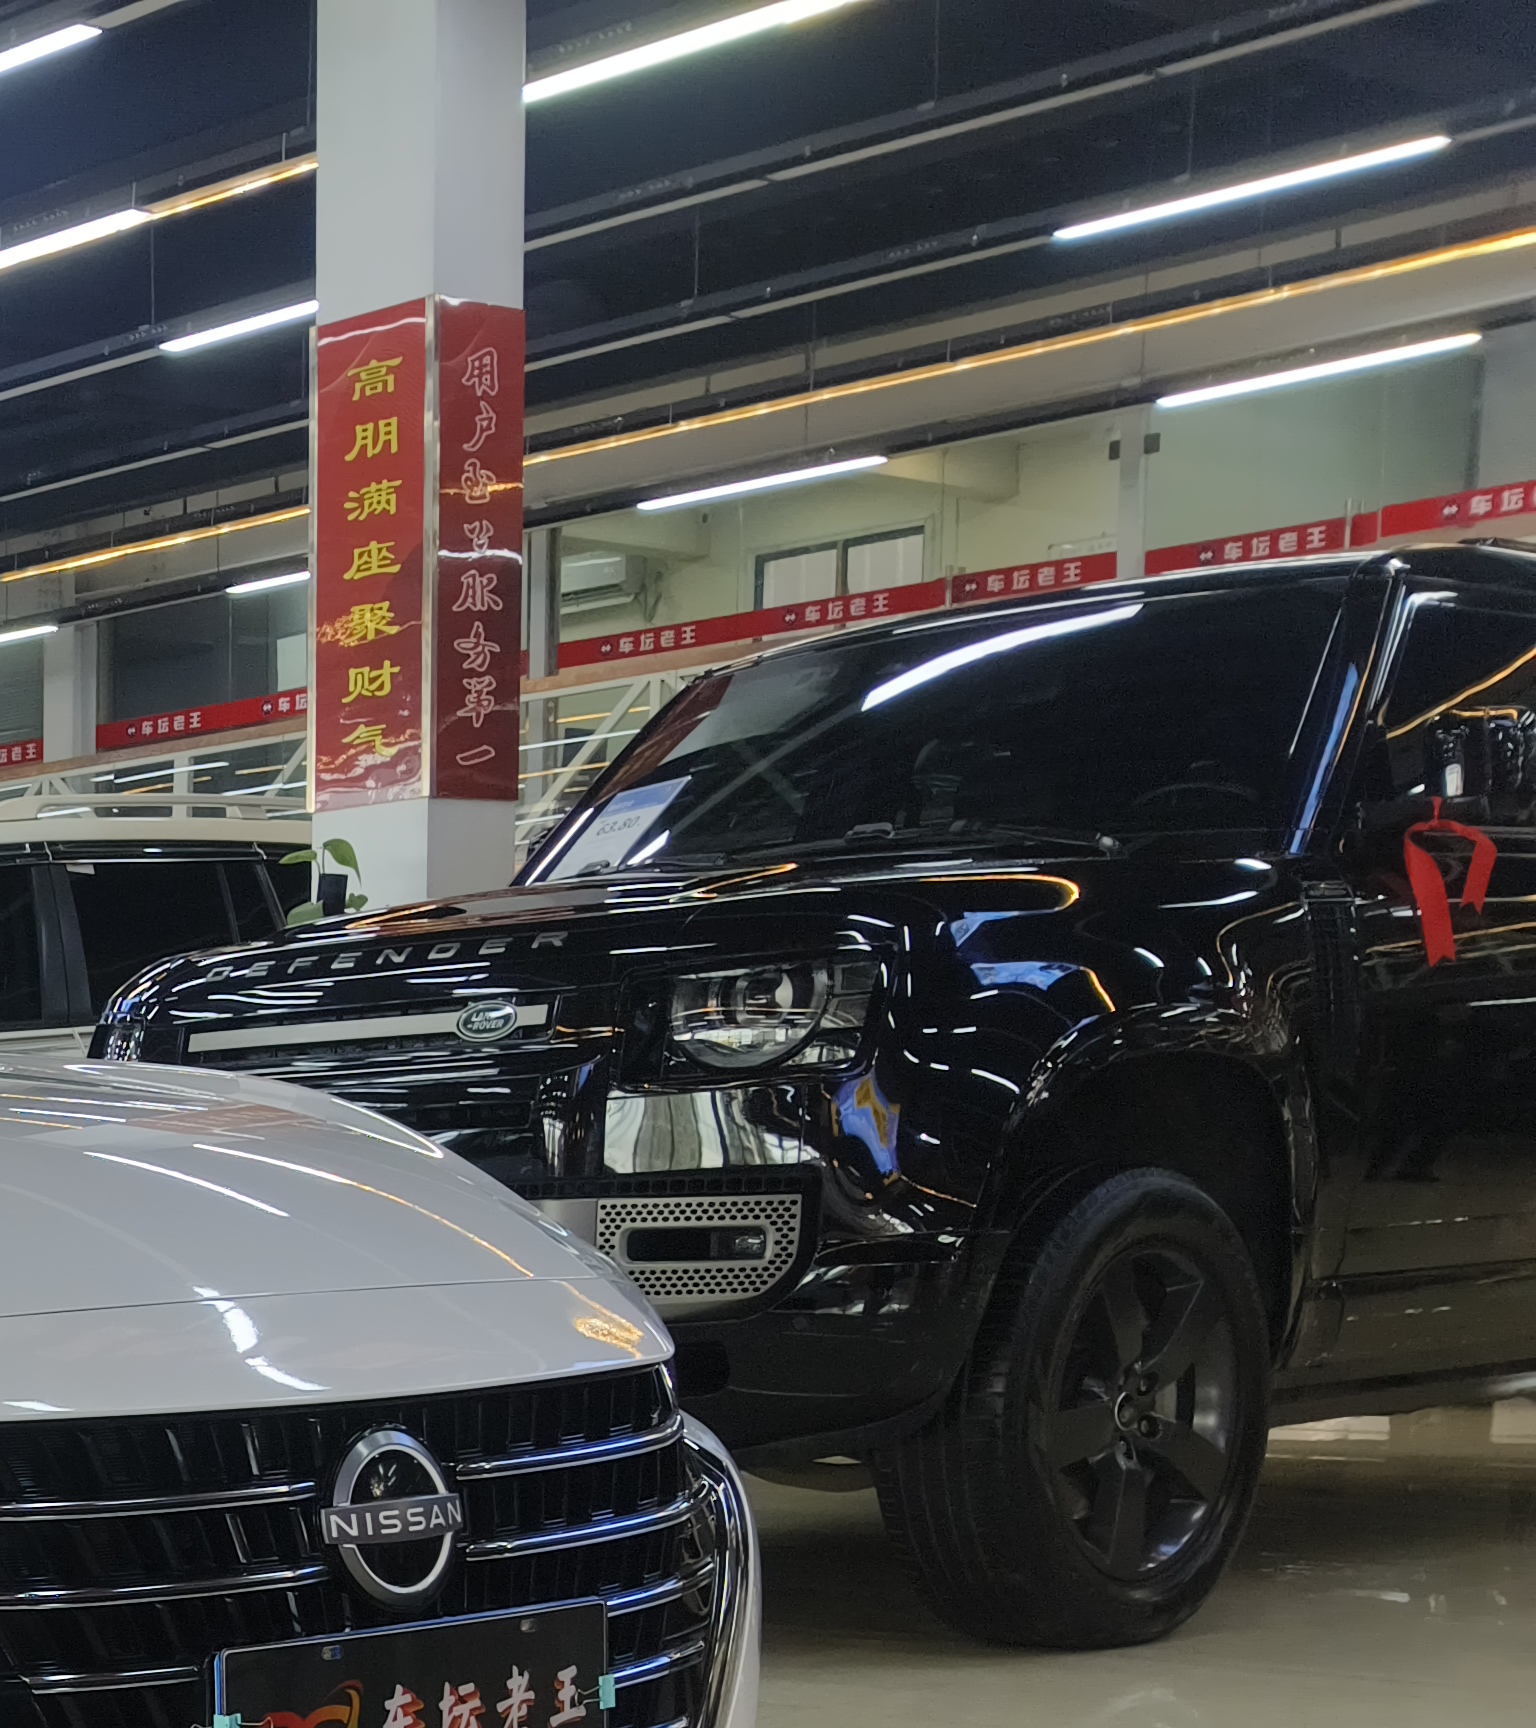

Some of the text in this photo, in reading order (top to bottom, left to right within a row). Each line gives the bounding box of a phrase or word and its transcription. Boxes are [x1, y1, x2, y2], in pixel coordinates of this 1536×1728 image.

[1469, 488, 1536, 516] 车坛
[340, 355, 404, 758] 高朋满座聚财气
[1223, 525, 1327, 562] 车坛老王
[986, 560, 1083, 593] 车坛老王
[804, 591, 891, 623] 车坛老王
[618, 625, 697, 654] 车坛老王
[205, 930, 569, 983] DEFENDER
[471, 1018, 505, 1031] ROVER
[328, 1497, 463, 1539] NISSAN
